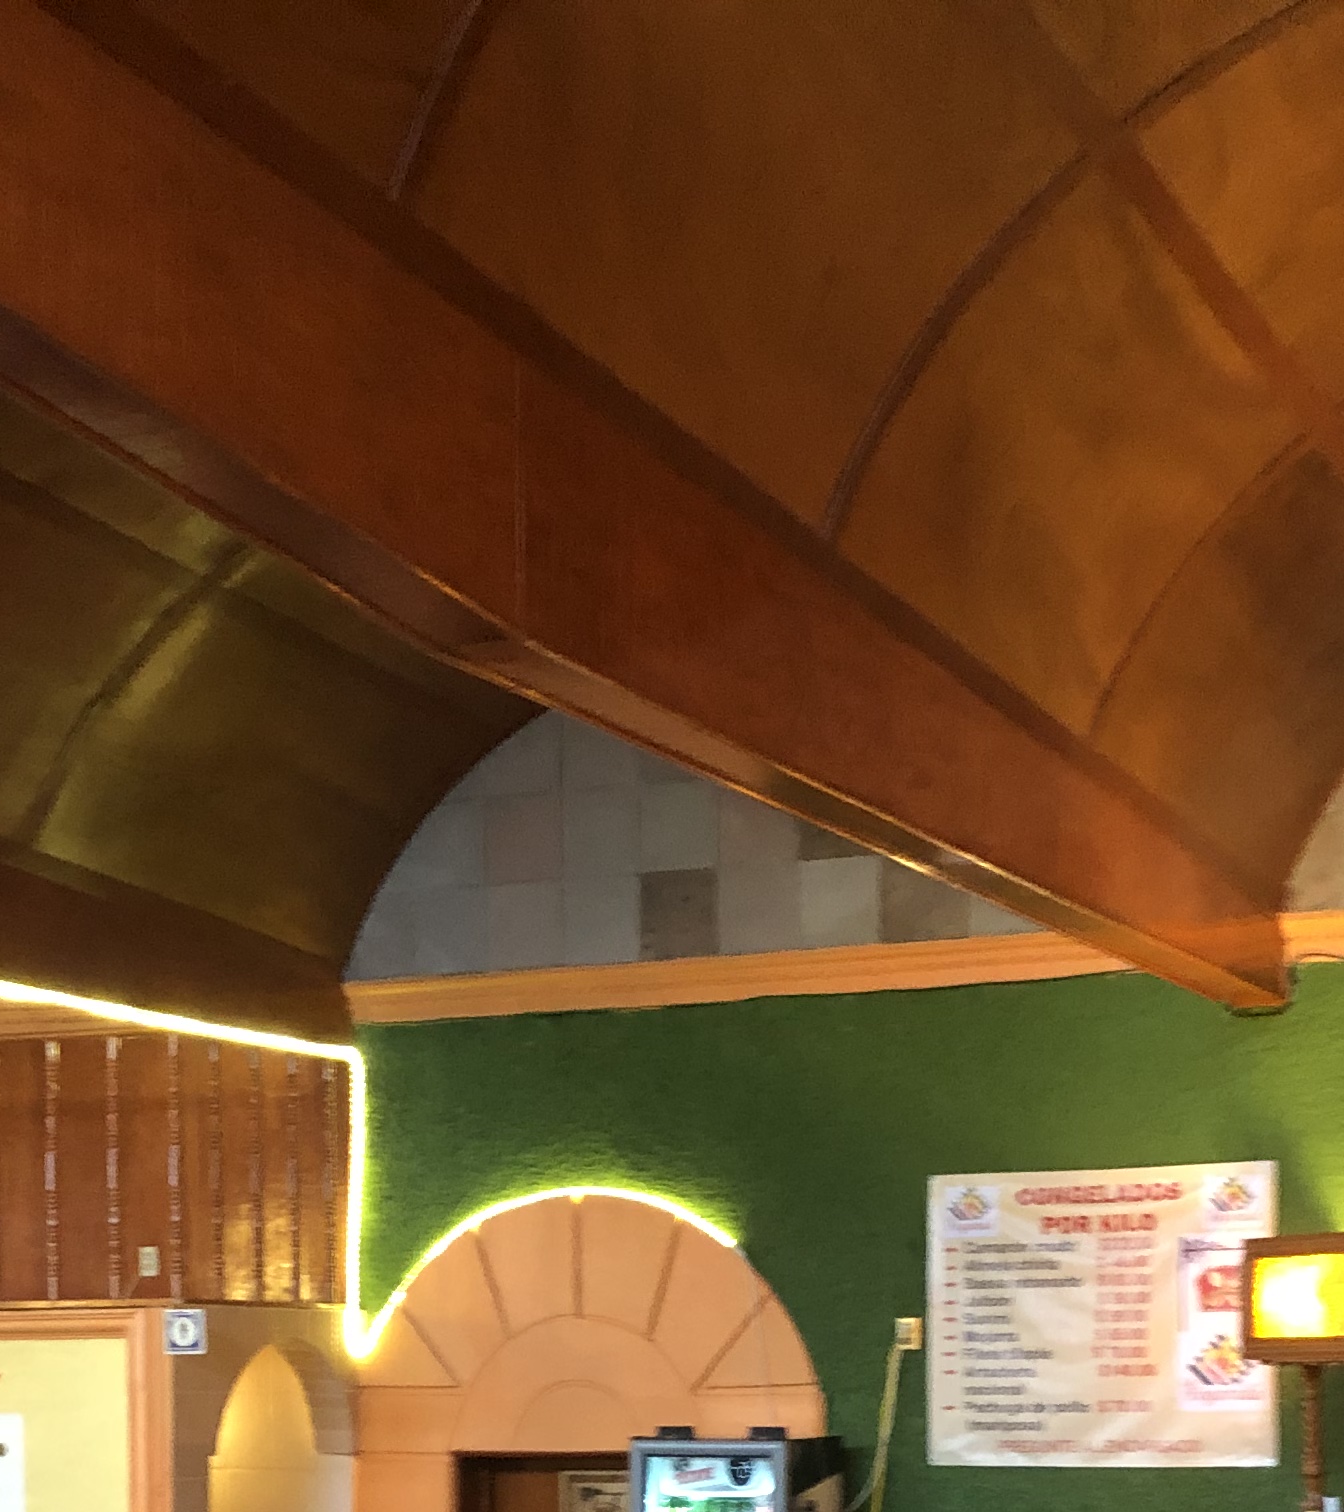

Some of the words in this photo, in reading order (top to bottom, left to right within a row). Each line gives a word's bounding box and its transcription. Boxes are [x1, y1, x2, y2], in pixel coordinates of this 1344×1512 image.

[1016, 1183, 1182, 1205] CONGELADOS
[1042, 1215, 1092, 1234] POR
[1099, 1213, 1157, 1233] KILO
